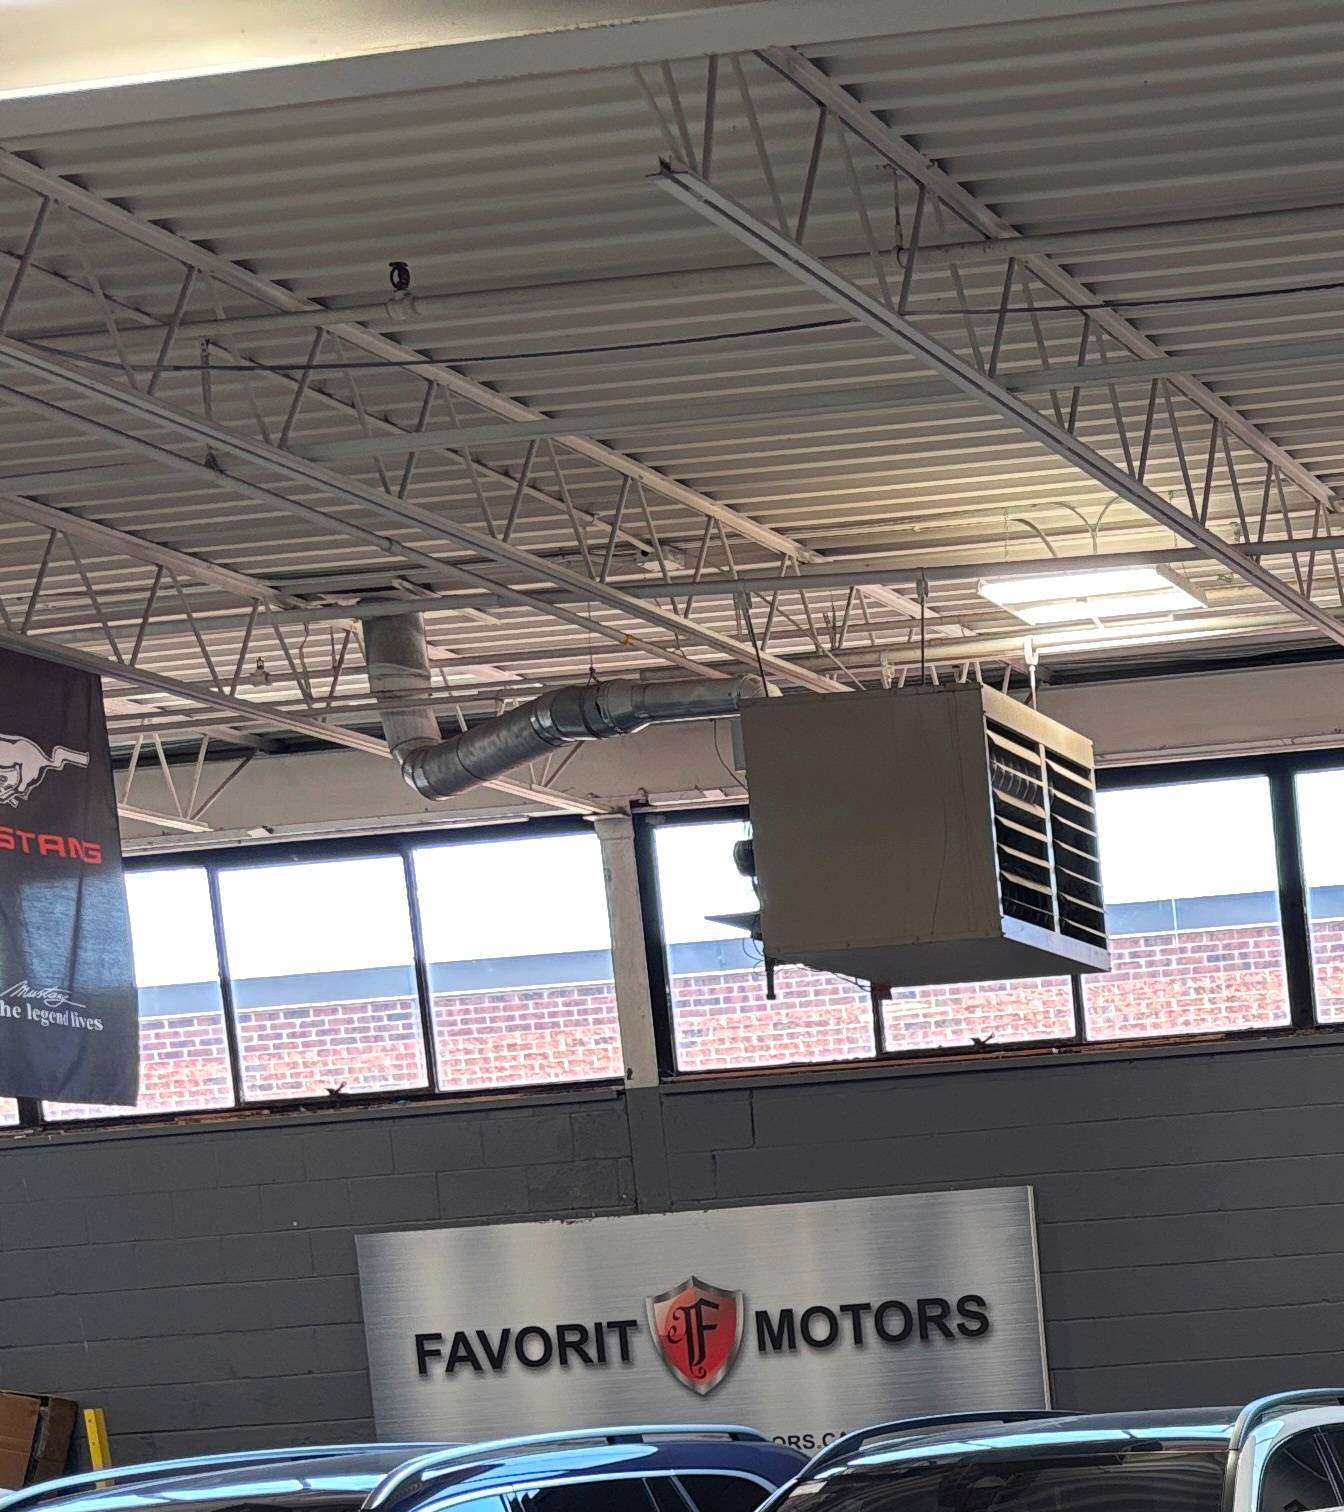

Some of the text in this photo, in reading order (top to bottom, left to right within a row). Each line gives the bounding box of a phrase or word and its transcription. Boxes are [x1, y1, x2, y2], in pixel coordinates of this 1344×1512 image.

[26, 1003, 69, 1027] legend
[70, 1010, 104, 1032] lives
[414, 1318, 639, 1375] FAVORIT
[755, 1294, 990, 1352] MOTORS
